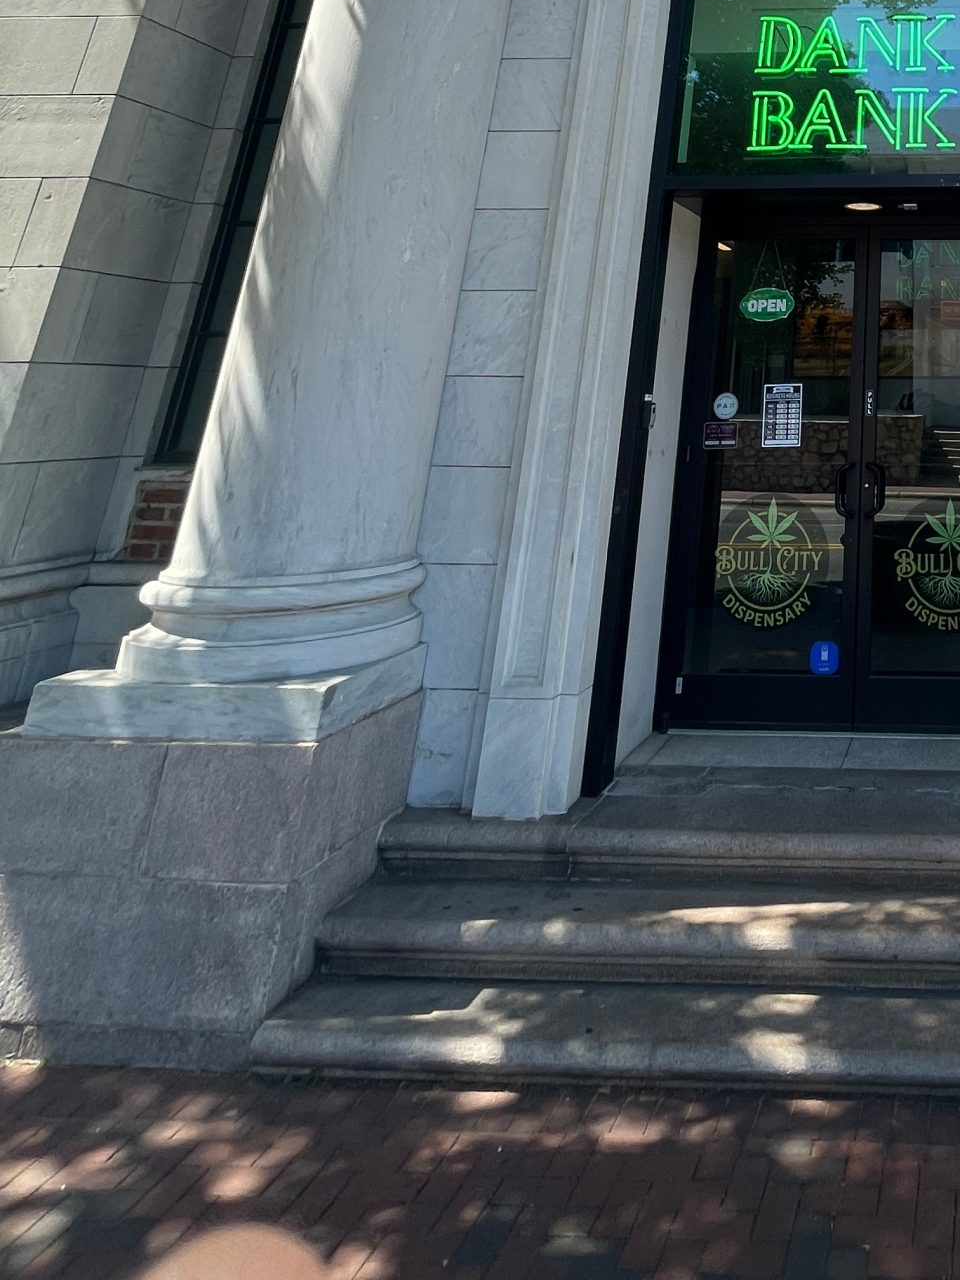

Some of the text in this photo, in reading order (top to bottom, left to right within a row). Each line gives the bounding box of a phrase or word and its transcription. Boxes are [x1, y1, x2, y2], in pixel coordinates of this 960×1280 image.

[753, 13, 957, 75] DANK
[746, 87, 959, 152] BANK
[747, 299, 787, 313] OPEN
[714, 546, 823, 579] BULL CITY
[893, 549, 950, 582] BULL
[722, 591, 811, 628] DISPENSARY
